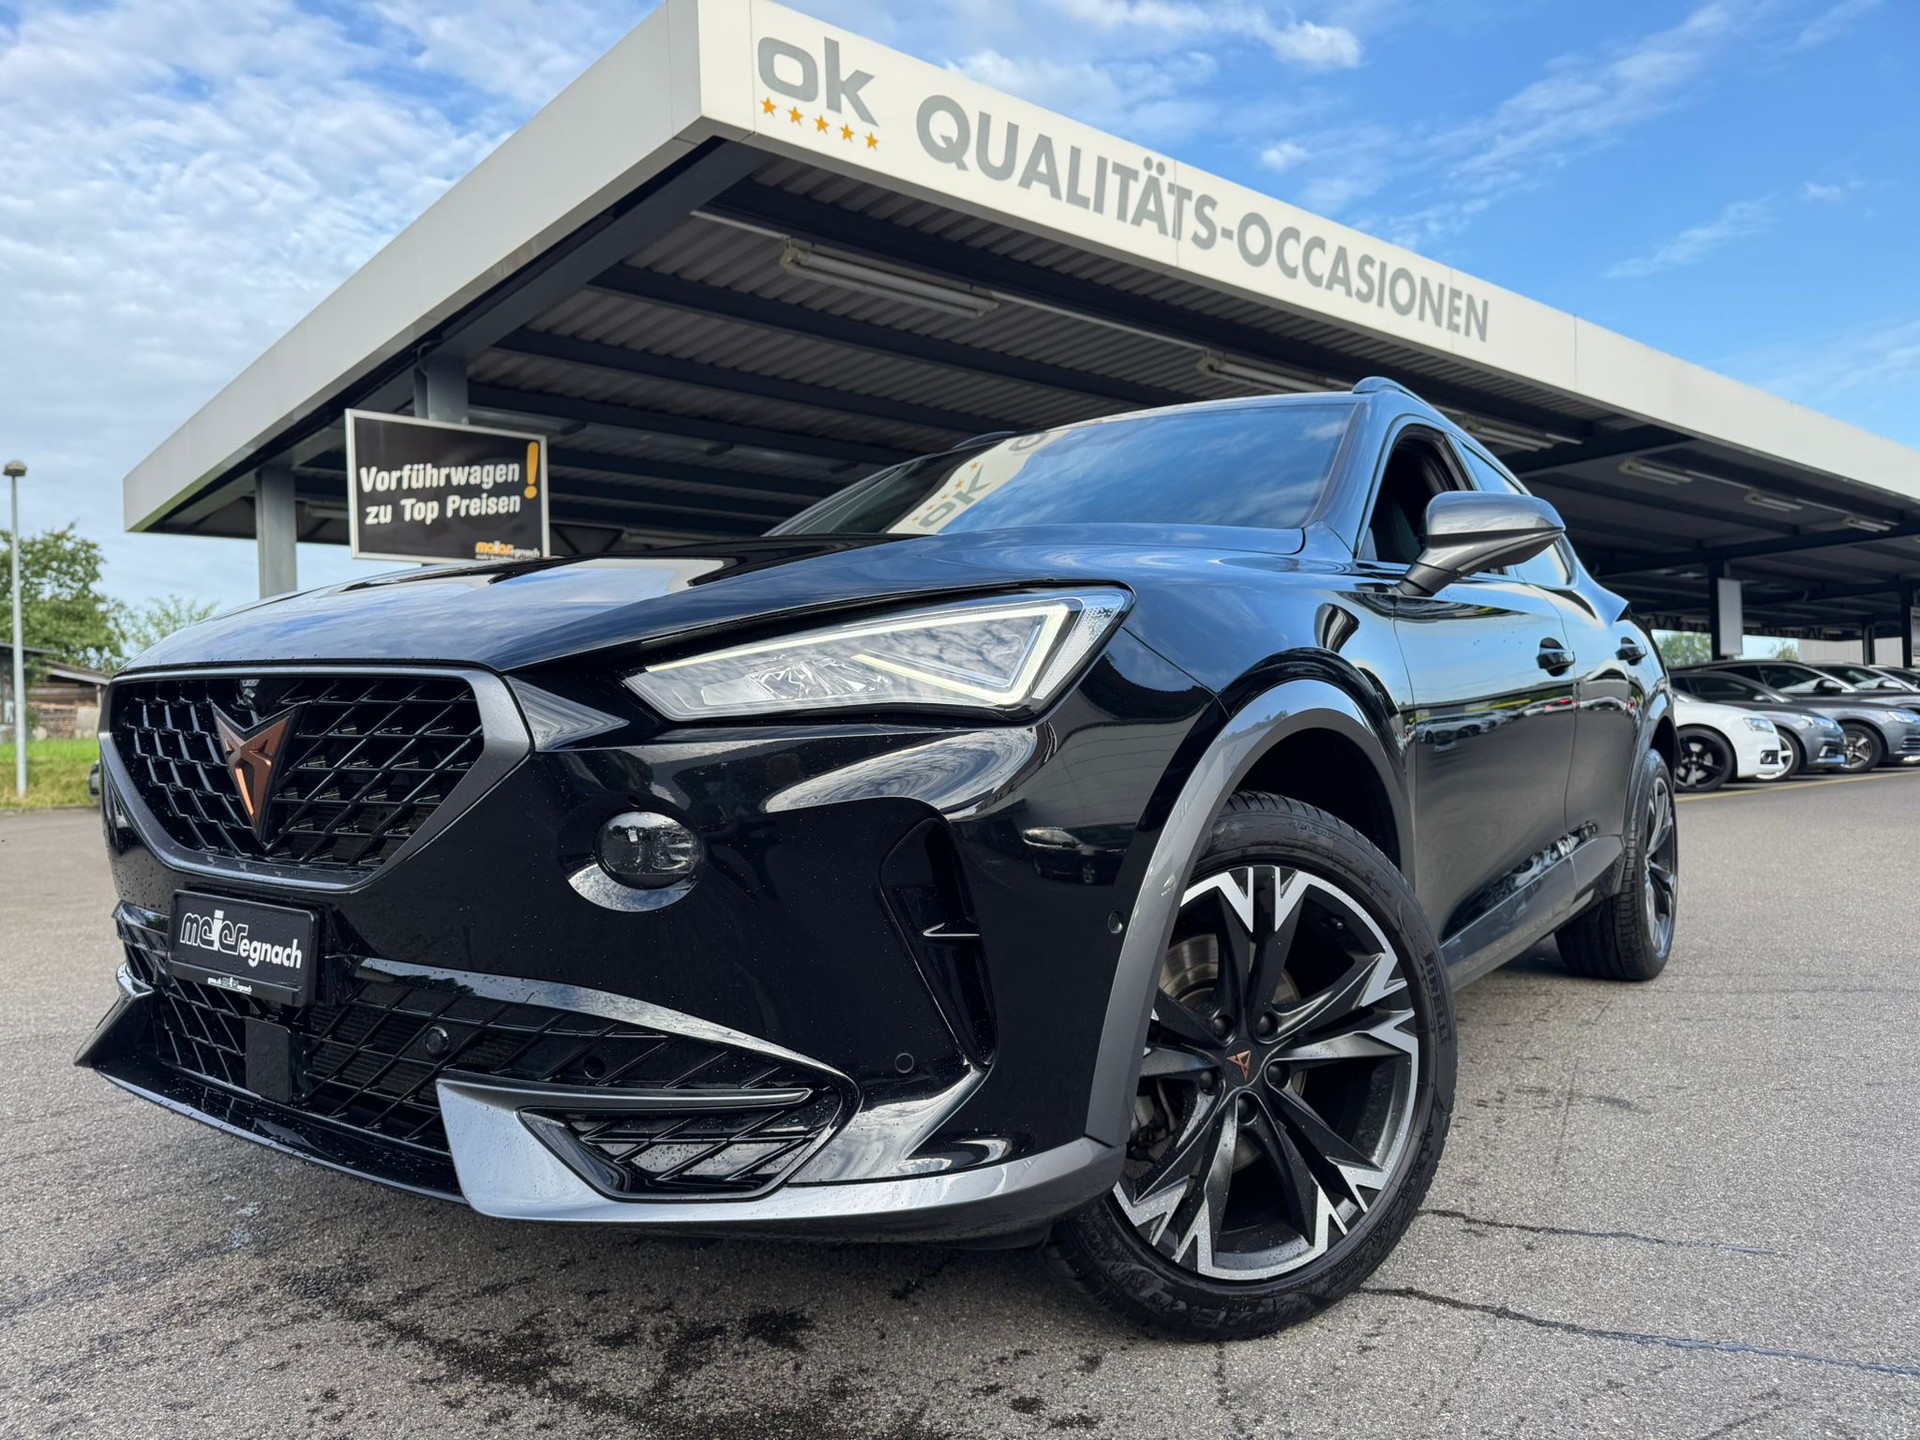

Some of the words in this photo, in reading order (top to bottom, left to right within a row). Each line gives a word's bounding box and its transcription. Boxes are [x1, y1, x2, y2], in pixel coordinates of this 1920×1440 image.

[758, 36, 879, 127] ok
[915, 94, 1488, 342] QUALITÄTS-OCCASIONEN
[359, 463, 520, 493] Vorführwagen
[365, 504, 392, 525] zu
[400, 498, 439, 525] Top
[446, 493, 521, 518] Preisen
